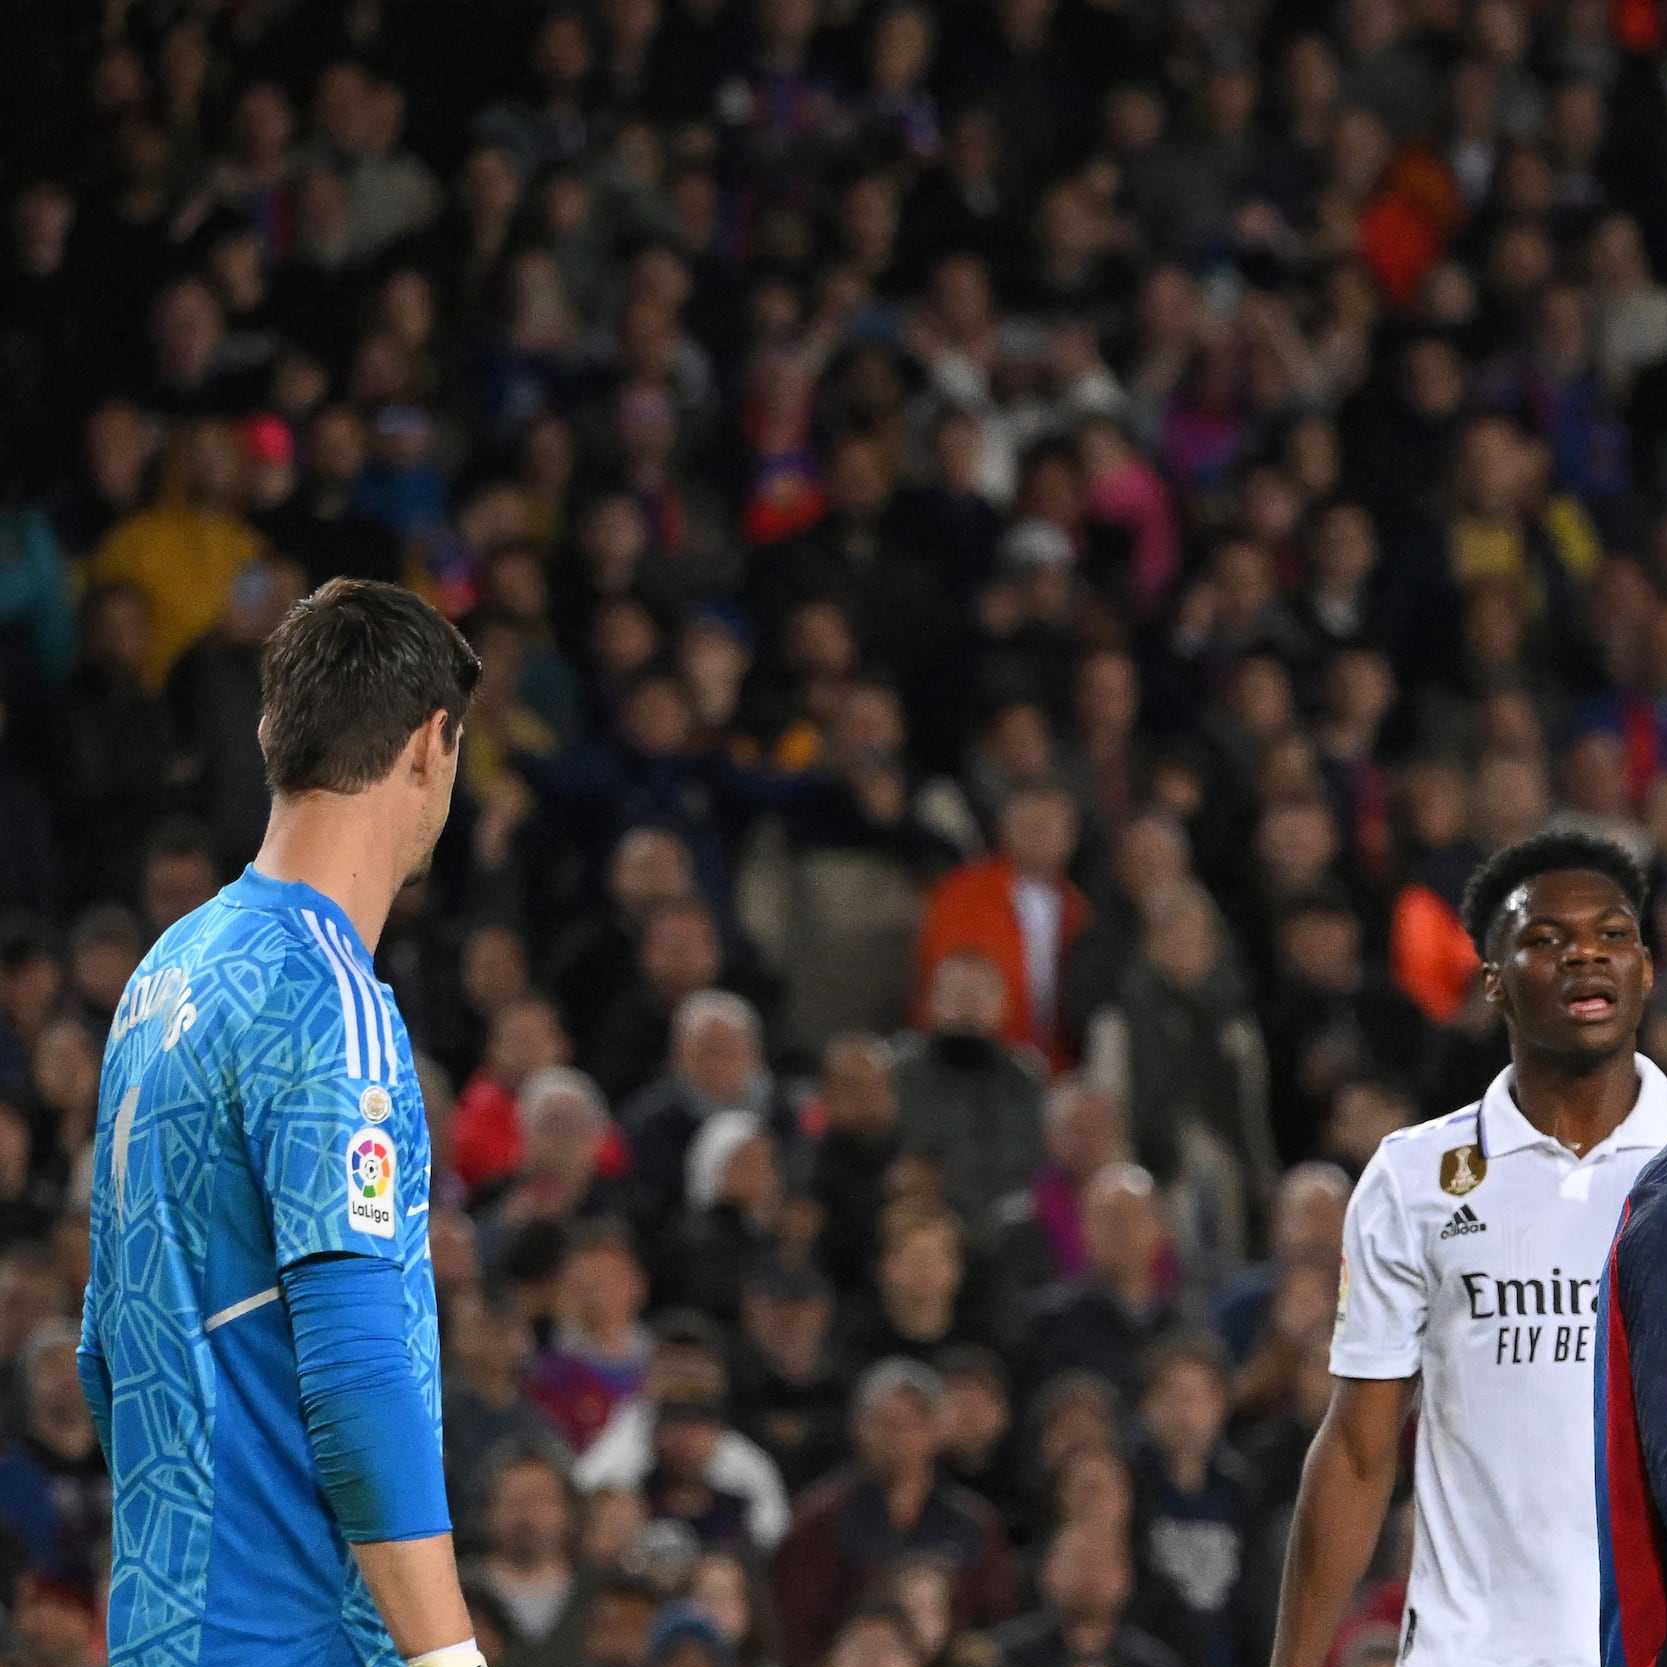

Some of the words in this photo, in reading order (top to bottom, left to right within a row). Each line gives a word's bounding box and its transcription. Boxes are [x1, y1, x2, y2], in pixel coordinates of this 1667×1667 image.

[352, 1201, 390, 1223] LaLiga
[1440, 1222, 1488, 1240] adidas
[1497, 1327, 1542, 1364] FLY
